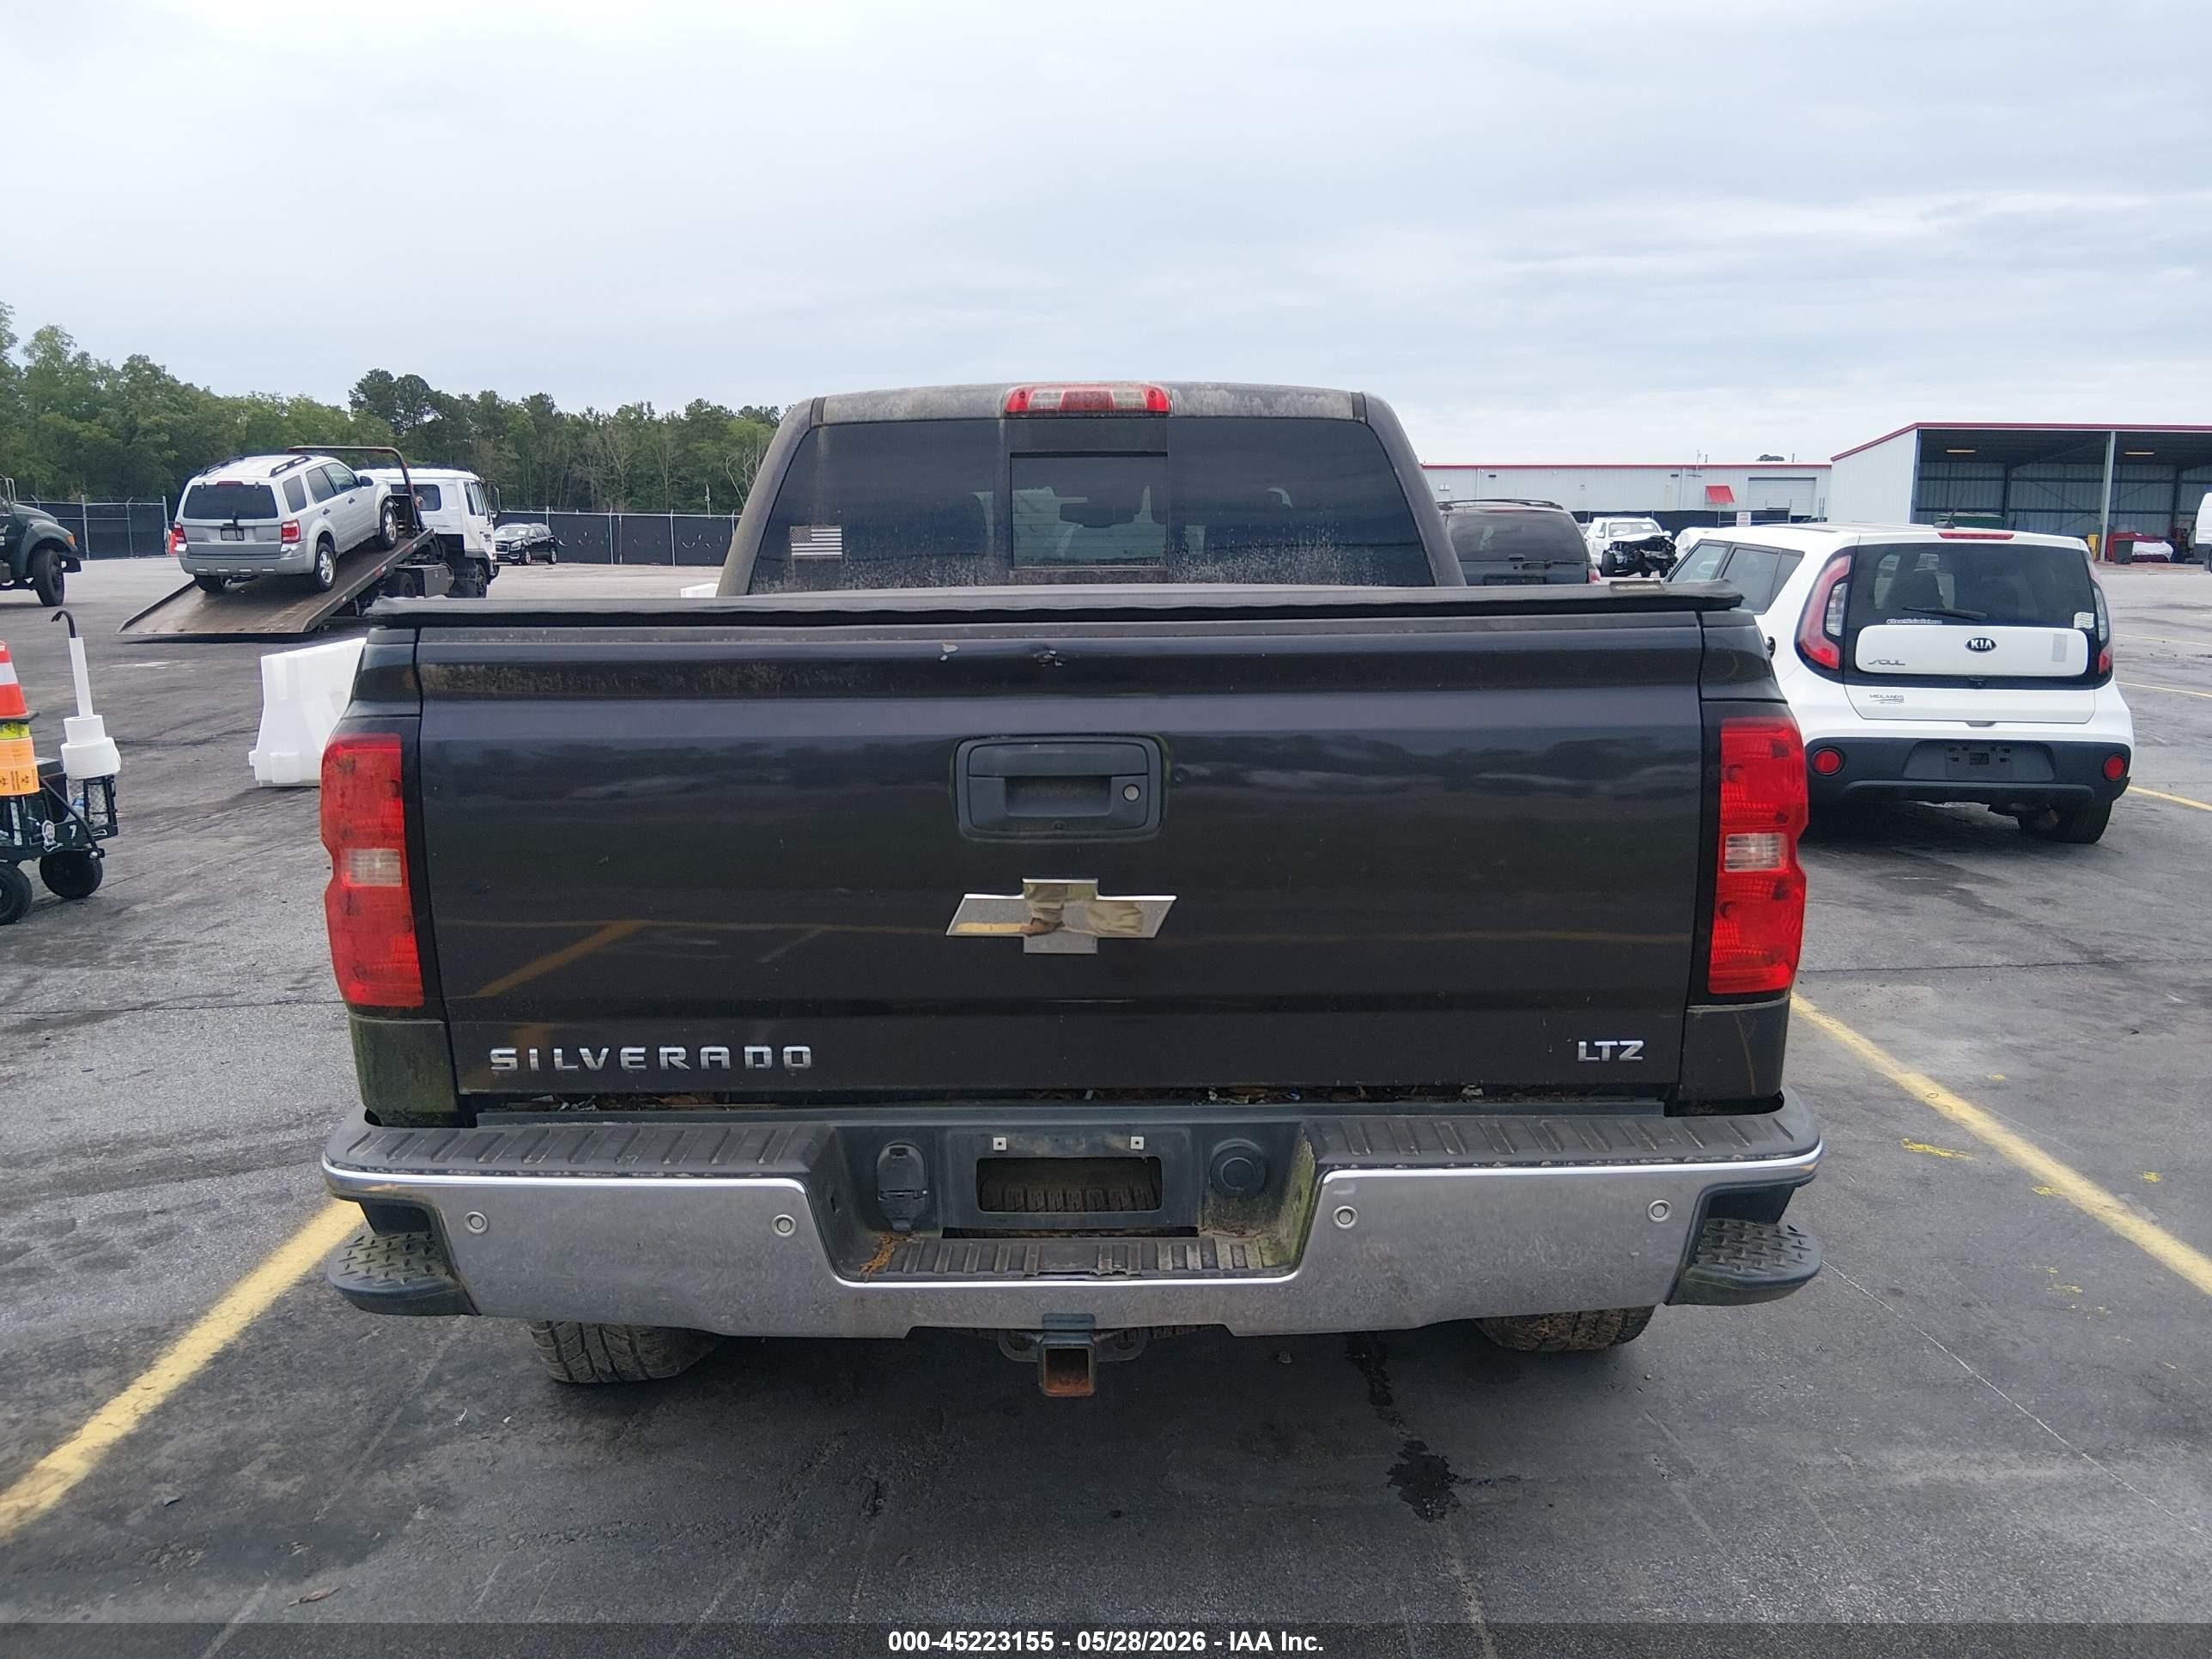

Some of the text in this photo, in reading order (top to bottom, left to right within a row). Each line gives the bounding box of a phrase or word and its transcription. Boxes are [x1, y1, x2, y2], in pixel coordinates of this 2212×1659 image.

[1971, 639, 1992, 649] KIA
[489, 1045, 812, 1071] SILVERADO
[1577, 1040, 1644, 1061] LTZ
